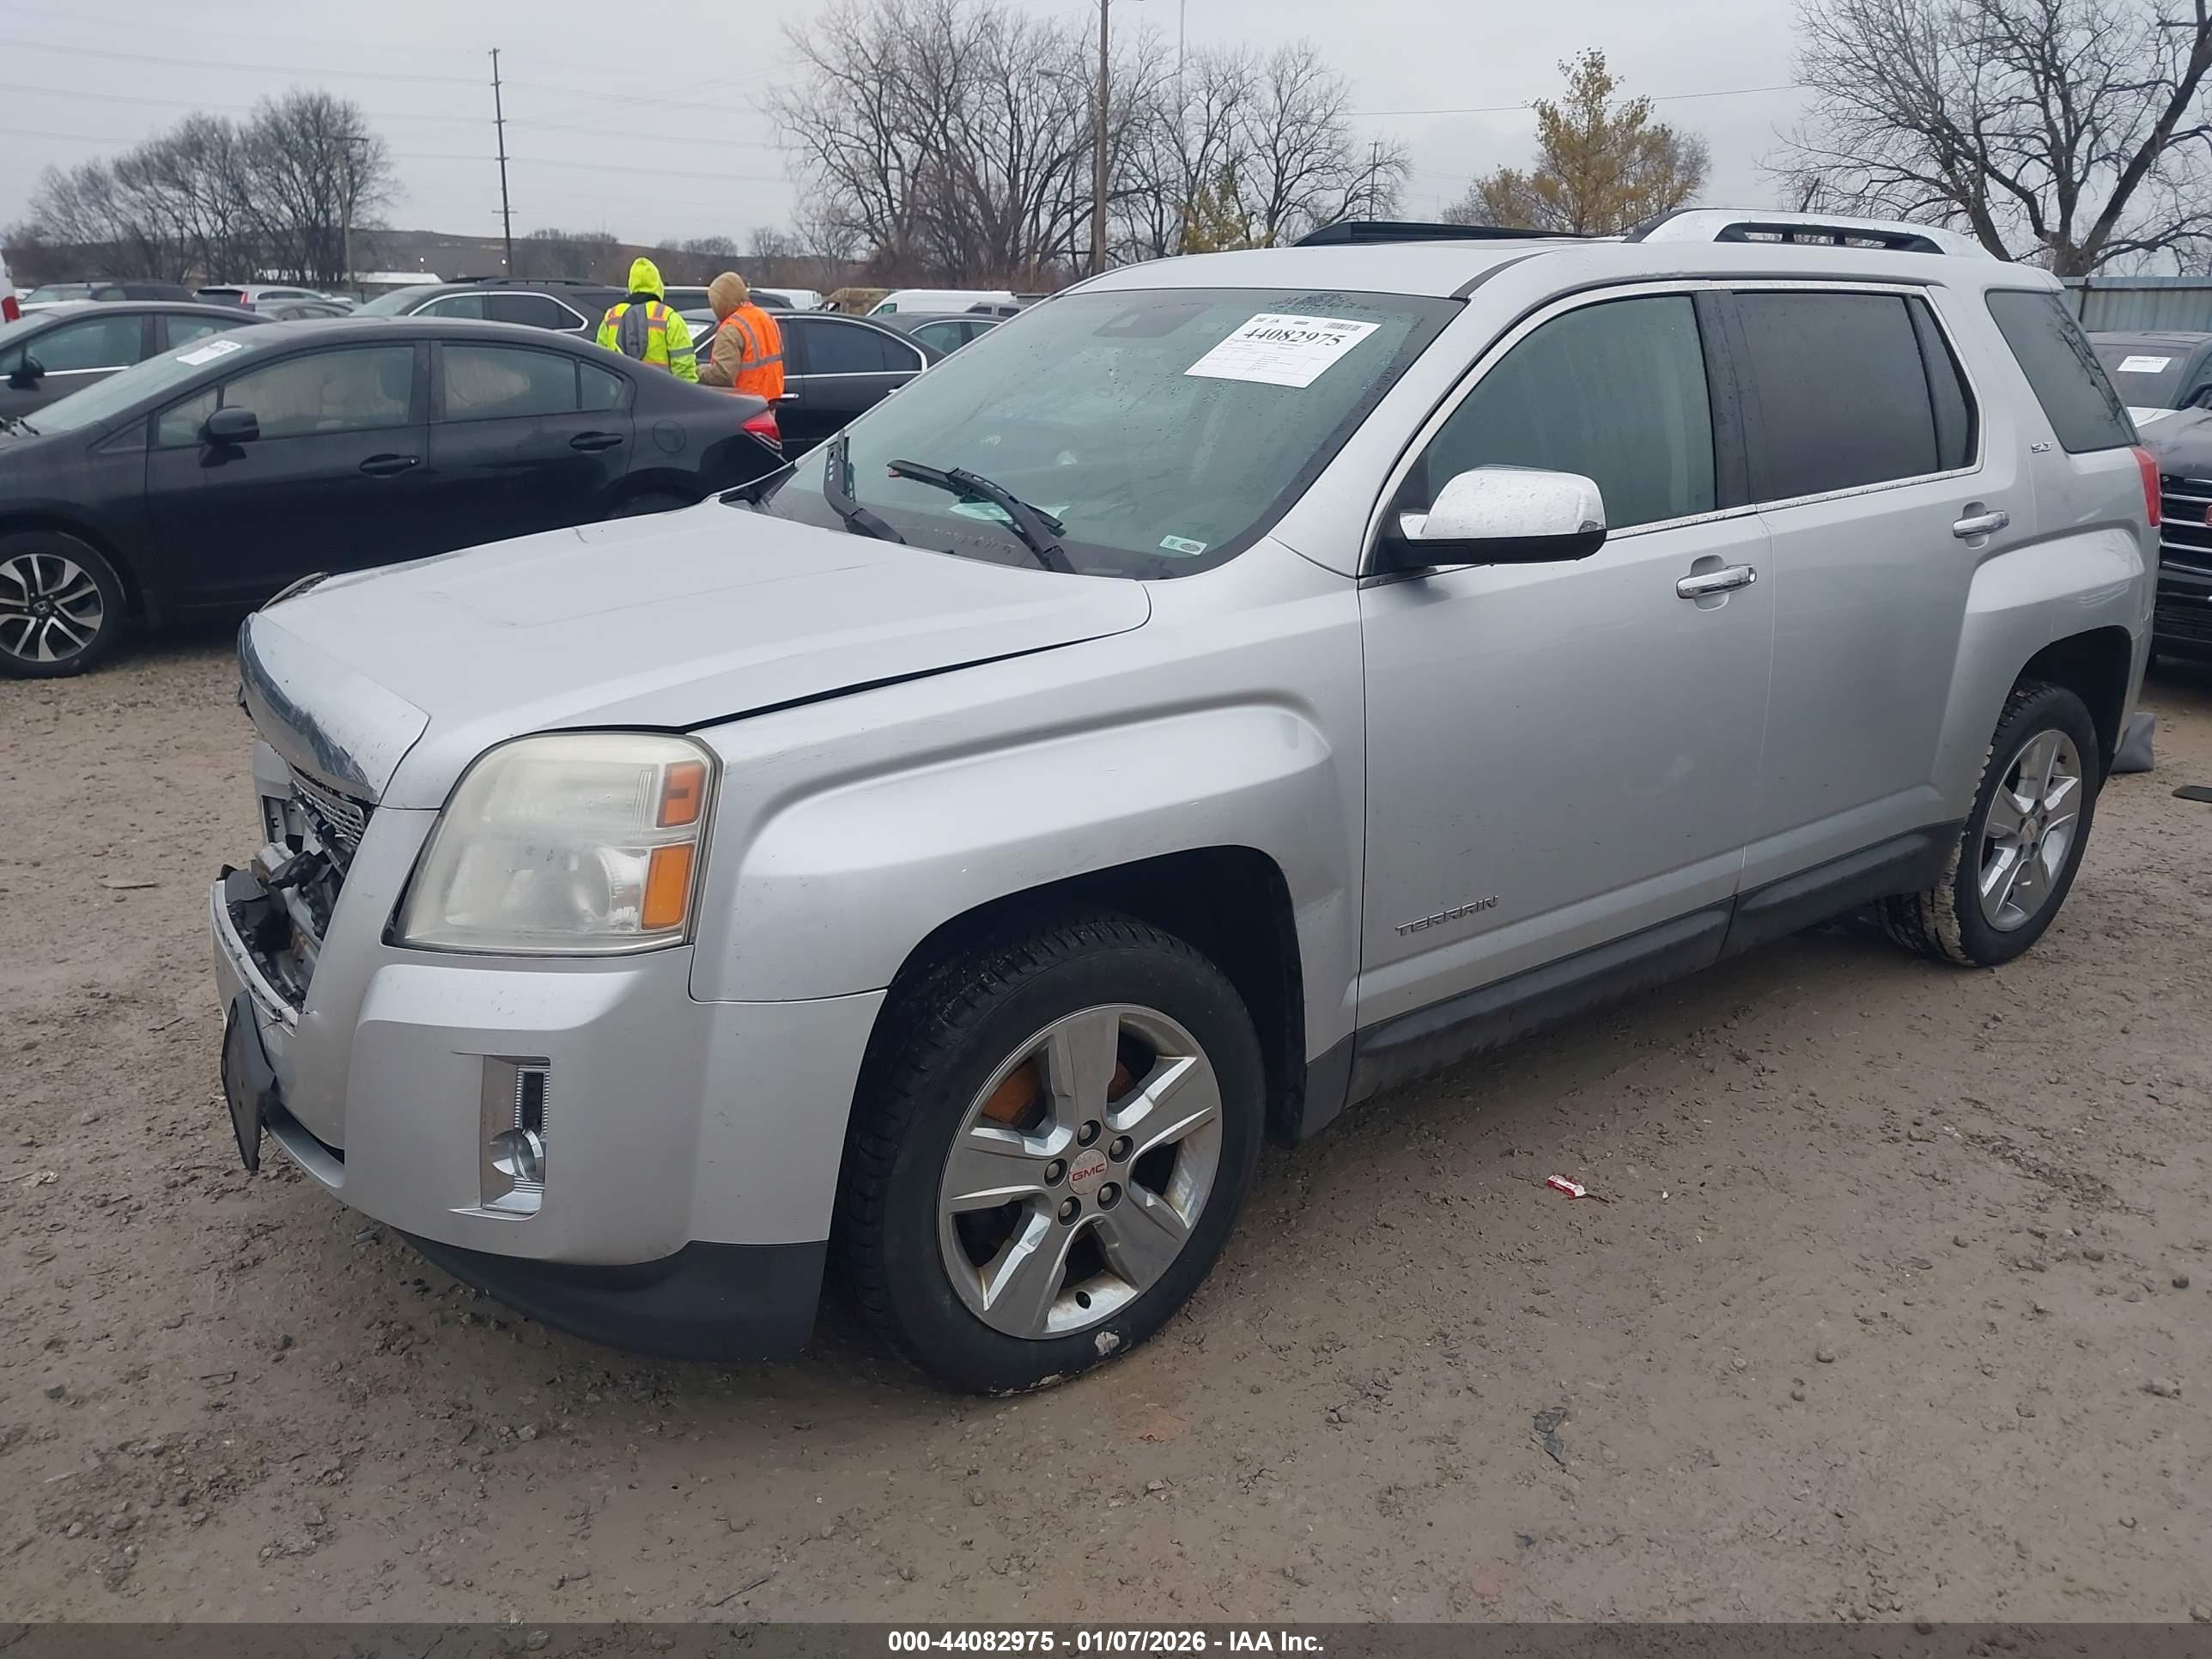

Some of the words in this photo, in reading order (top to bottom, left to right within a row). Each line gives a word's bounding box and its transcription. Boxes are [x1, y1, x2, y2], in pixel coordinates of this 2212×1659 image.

[1244, 327, 1347, 346] 44082975
[1395, 895, 1498, 936] TERRAIN
[1072, 1163, 1105, 1182] GMC
